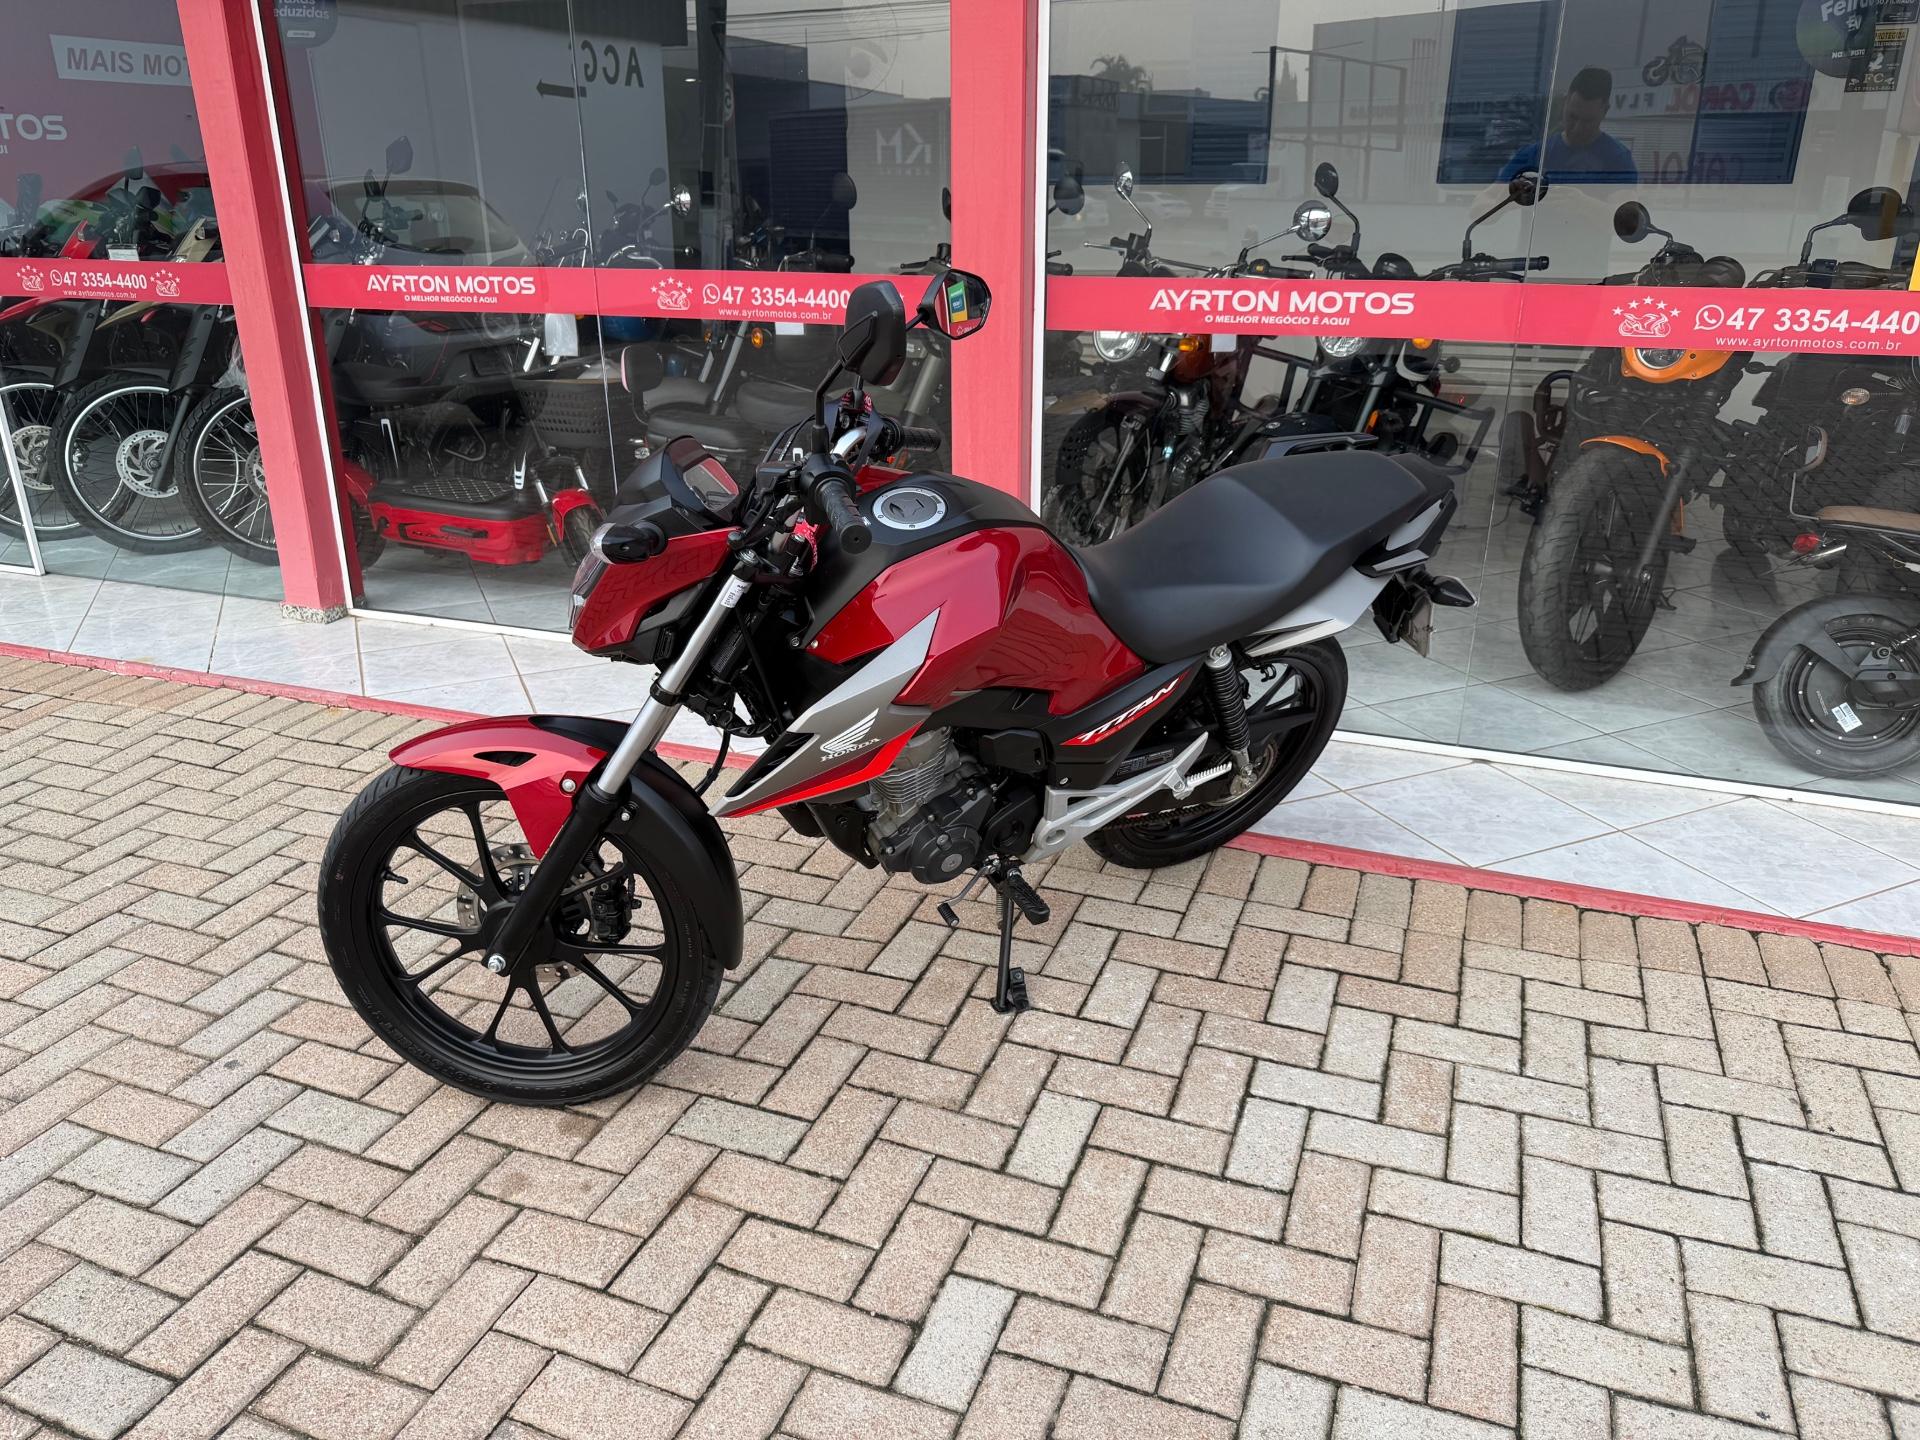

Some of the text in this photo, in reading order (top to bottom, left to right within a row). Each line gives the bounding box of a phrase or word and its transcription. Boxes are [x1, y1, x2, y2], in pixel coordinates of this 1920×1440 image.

[66, 47, 134, 74] MAIS
[63, 271, 147, 290] 47 3354-4400
[367, 274, 536, 295] AYRTON MOTOS
[63, 289, 137, 299] www.ayrtonmotos.com.br
[440, 295, 472, 303] NEGÓCIO
[722, 285, 851, 309] 47 3354-4400
[1149, 288, 1416, 315] AYRTON MOTOS
[718, 308, 832, 320] www.ayrtonmotos.com.br
[1215, 315, 1259, 324] MELHOR
[1261, 315, 1311, 325] NEGÓCIO
[1321, 317, 1350, 326] AQUI
[1726, 307, 1765, 331] 47
[1715, 336, 1902, 351] www.ayrtonmotos.com.br
[1077, 676, 1180, 744] TITAN
[820, 737, 881, 762] HONDA
